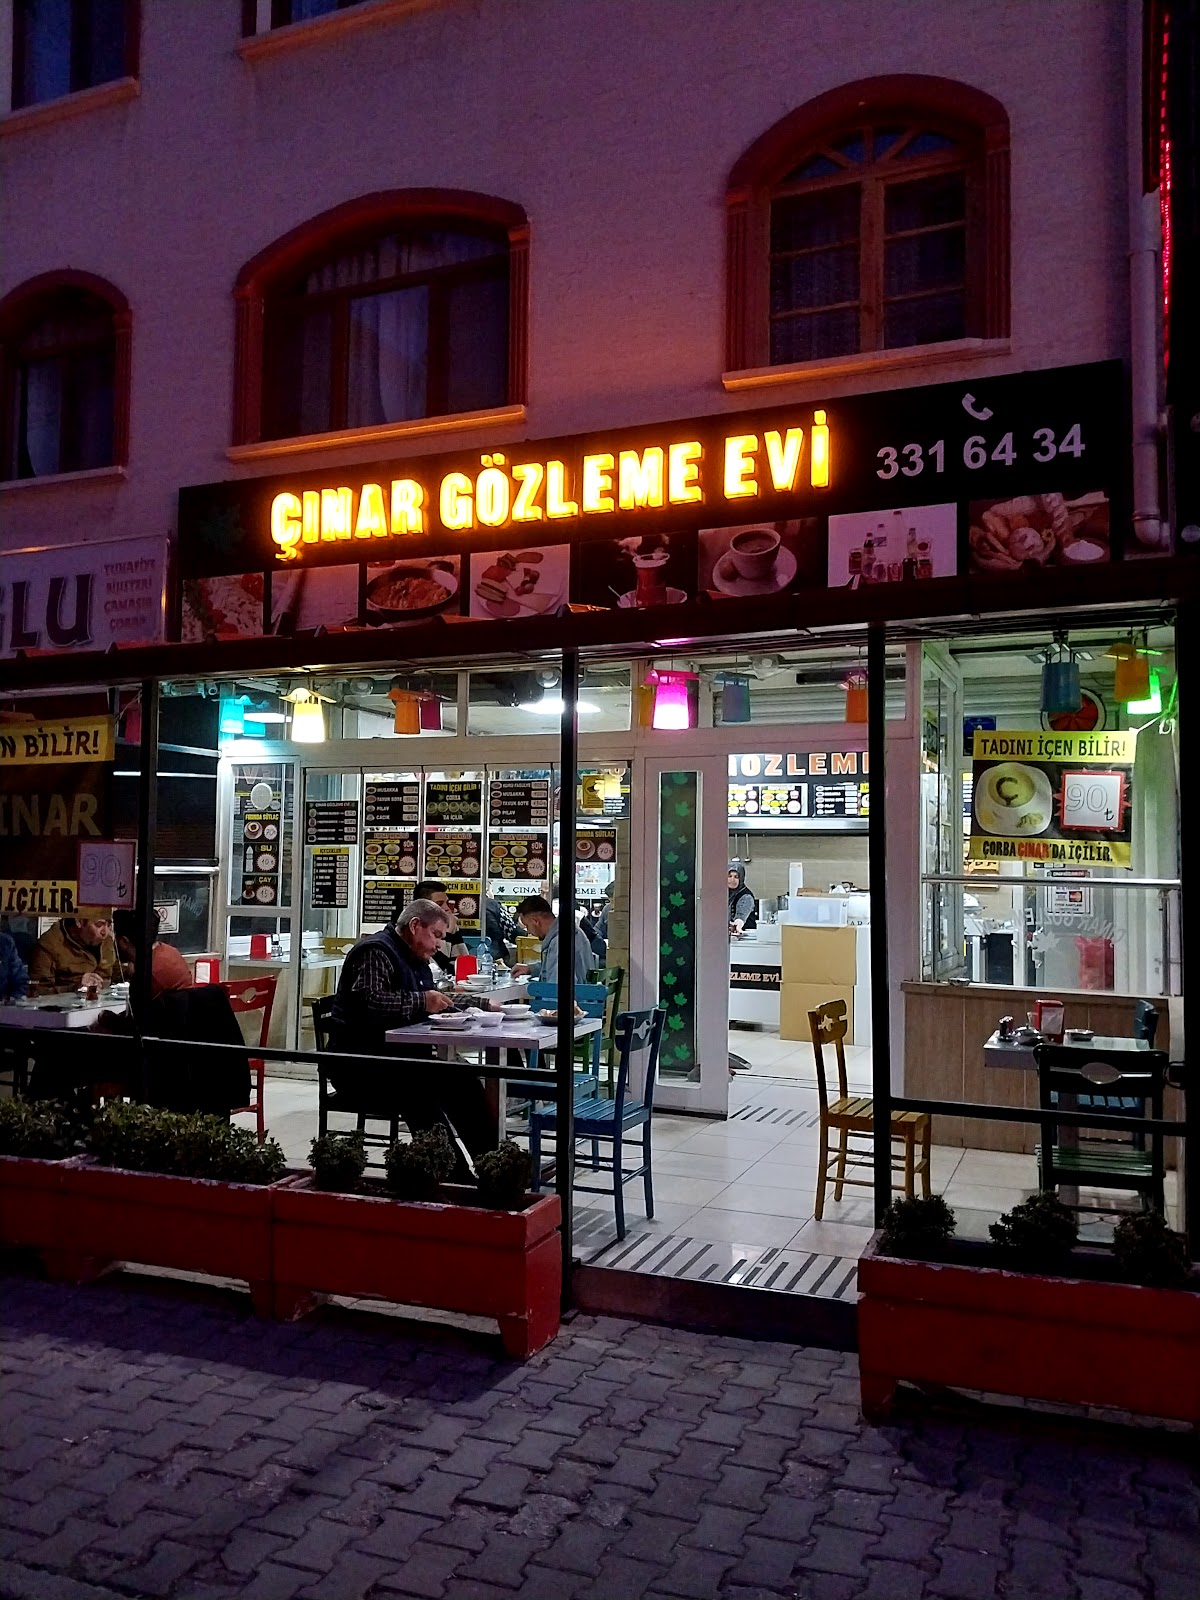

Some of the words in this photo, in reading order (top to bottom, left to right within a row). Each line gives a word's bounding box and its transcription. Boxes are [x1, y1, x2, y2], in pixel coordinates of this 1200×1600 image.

[876, 440, 946, 480] 331
[963, 432, 1018, 471] 64
[1032, 423, 1087, 464] 34
[269, 477, 425, 562] ÇINAR
[439, 440, 704, 531] GÖZLEME
[722, 409, 830, 500] EVİ
[0, 573, 94, 650] LU
[23, 725, 99, 758] BİLİR!
[980, 738, 1033, 756] TADINI
[1037, 735, 1073, 760] İÇEN
[1078, 735, 1126, 757] BİLİR!
[982, 840, 1017, 859] ÇORBA
[1068, 840, 1113, 864] İÇİLİR.
[5, 881, 79, 915] İÇİLİR.
